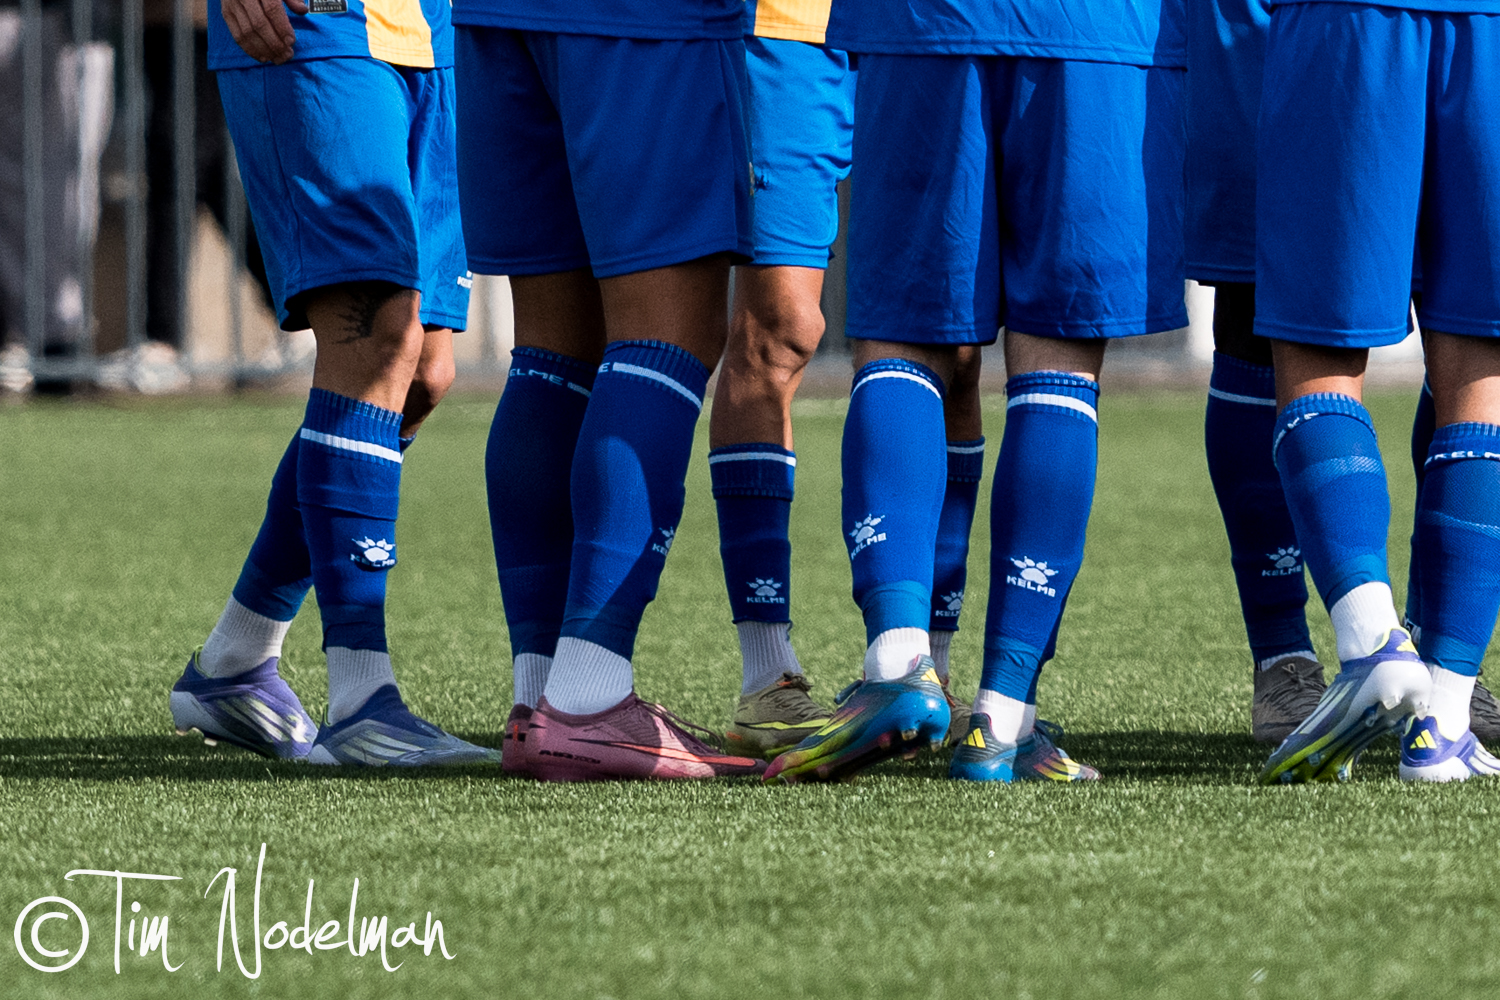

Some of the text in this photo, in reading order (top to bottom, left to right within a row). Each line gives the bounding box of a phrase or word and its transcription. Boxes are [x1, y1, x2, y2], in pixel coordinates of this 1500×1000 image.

[850, 532, 887, 560] KELME
[1261, 565, 1302, 577] KELME
[1006, 574, 1056, 597] KELME
[746, 596, 785, 604] KELME
